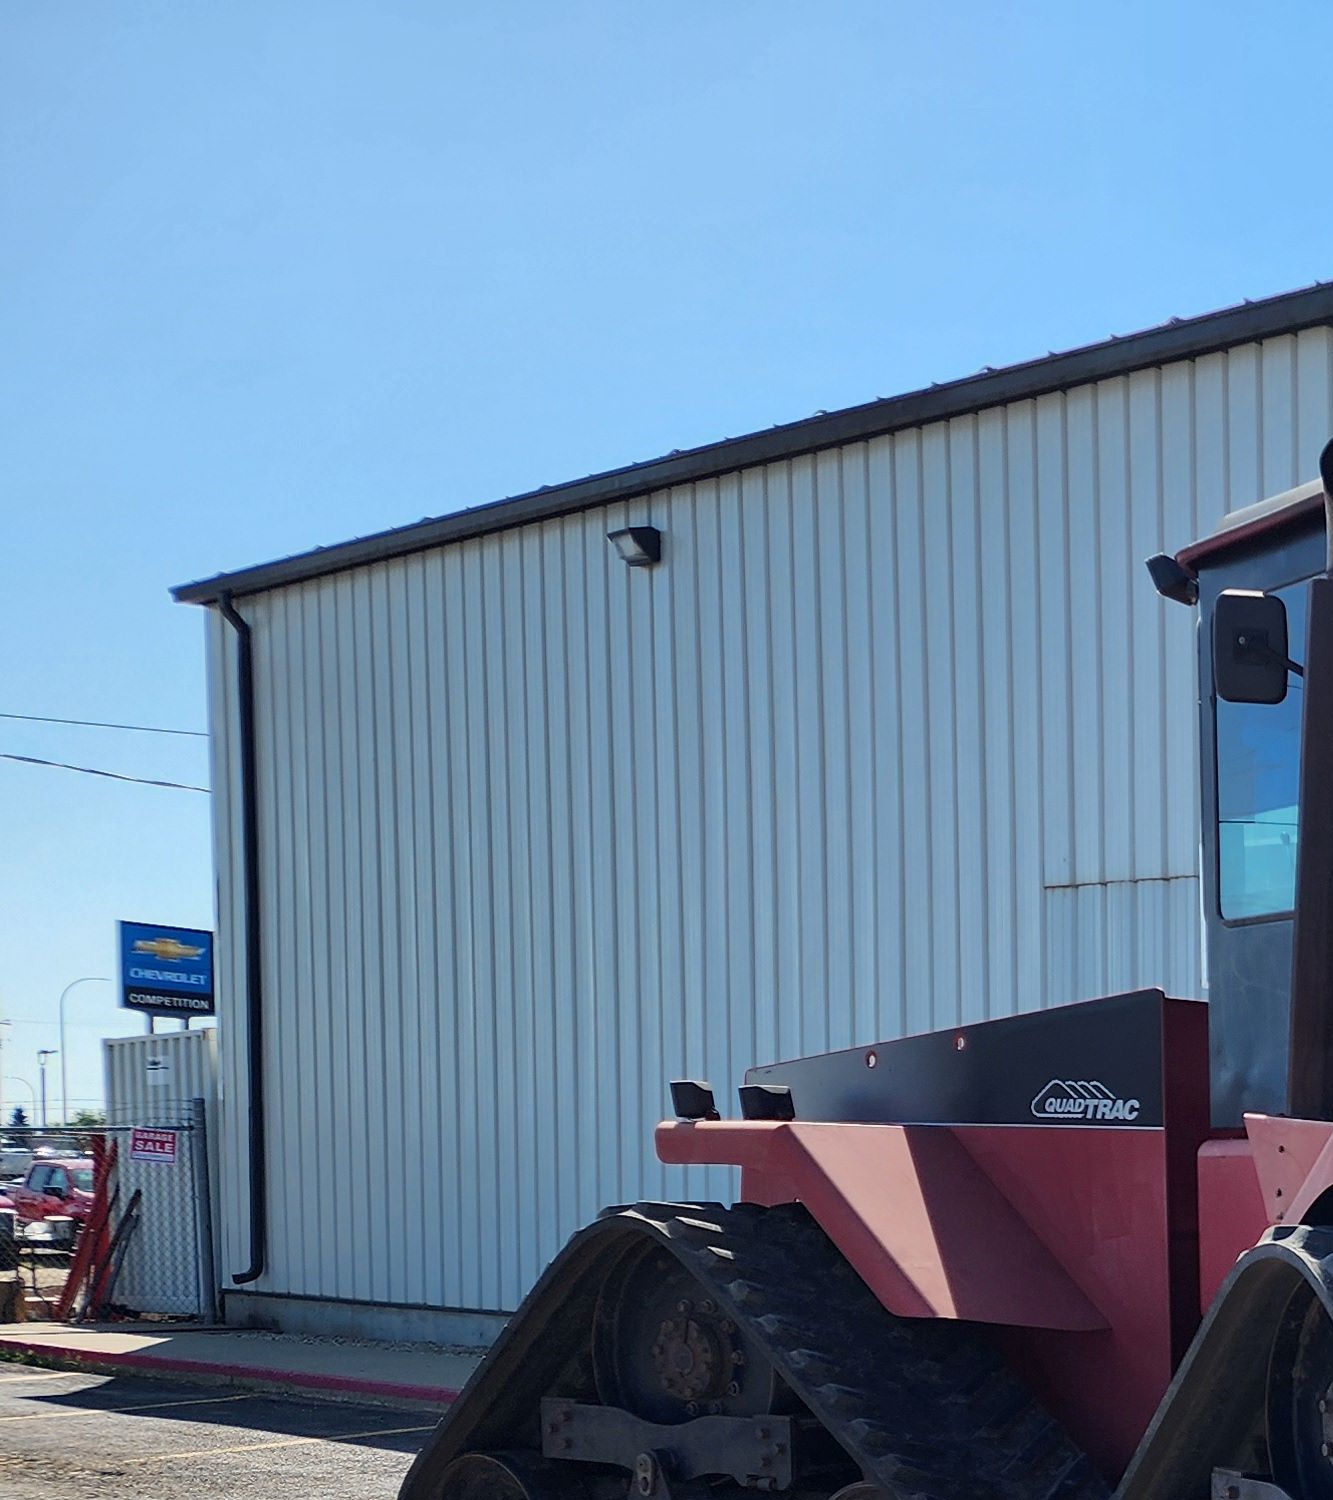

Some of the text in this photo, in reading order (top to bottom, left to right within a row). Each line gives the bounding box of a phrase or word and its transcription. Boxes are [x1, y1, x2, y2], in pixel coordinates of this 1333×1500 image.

[130, 968, 206, 985] CHEVROLET
[129, 993, 210, 1010] COMPETITION
[1044, 1097, 1140, 1120] QUADTRAC
[134, 1141, 174, 1154] SALE
